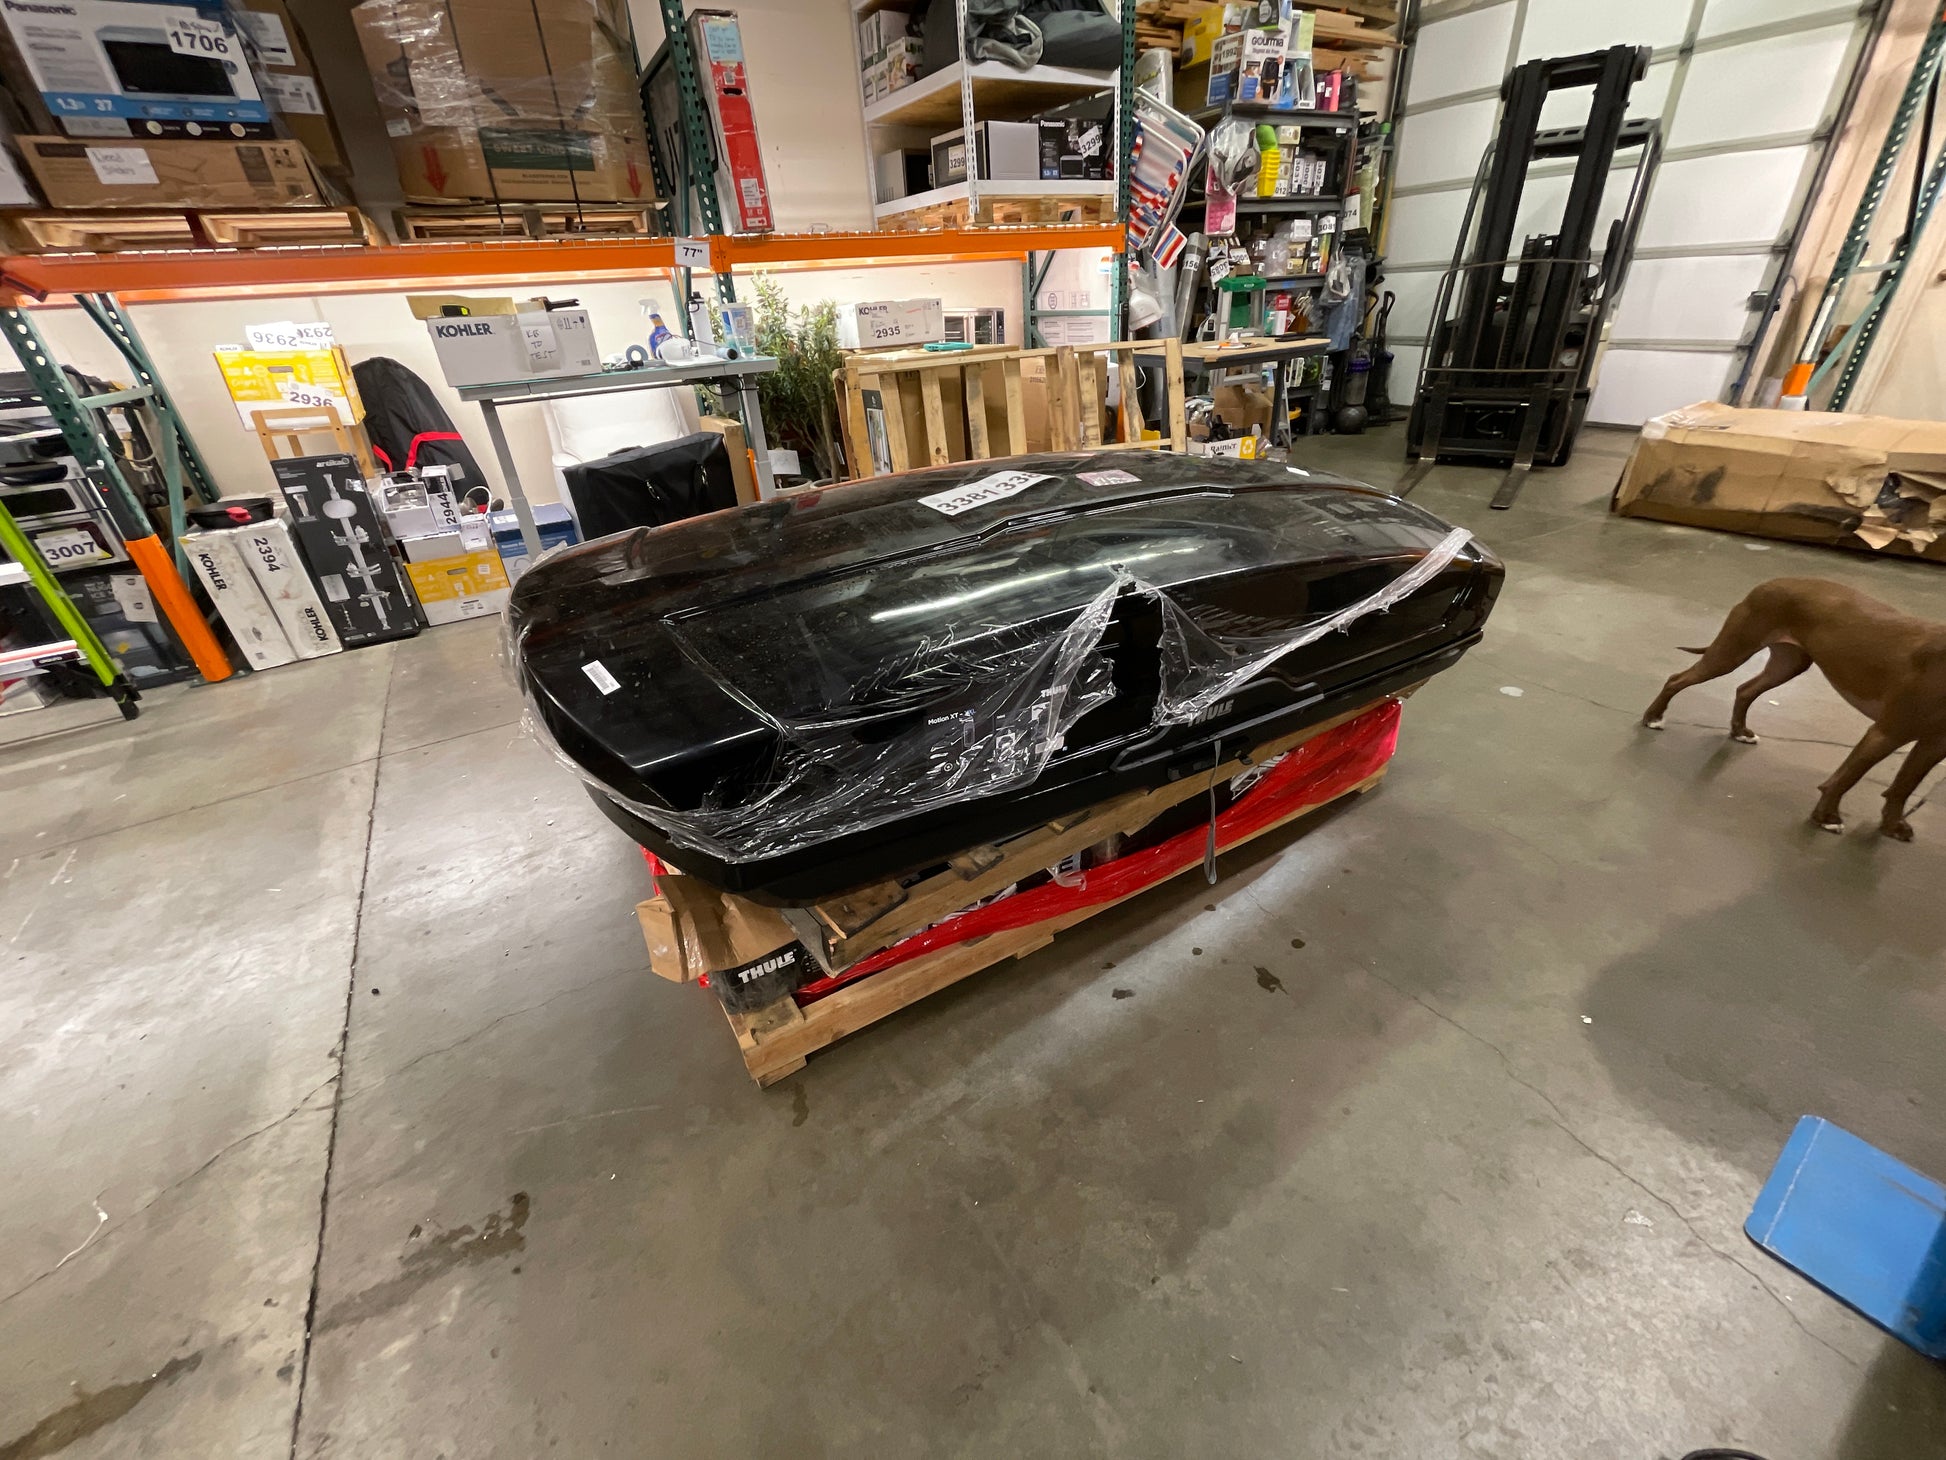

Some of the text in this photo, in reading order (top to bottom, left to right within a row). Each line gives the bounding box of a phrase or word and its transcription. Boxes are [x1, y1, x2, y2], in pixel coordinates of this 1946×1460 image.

[4, 0, 78, 16] Panasonic
[170, 30, 229, 54] 1706
[94, 98, 113, 112] 37
[1040, 120, 1066, 128] Panasonic
[1081, 134, 1101, 154] 3299
[949, 156, 966, 169] 3299
[252, 331, 298, 347] 2936
[435, 322, 493, 338] KOHLER
[875, 325, 901, 339] 2935
[530, 350, 557, 362] TEST
[437, 493, 458, 525] 2944
[936, 488, 998, 513] 3381
[46, 541, 96, 561] 3007
[253, 536, 281, 573] 2394
[198, 552, 227, 591] KOHLER
[304, 606, 329, 642] KOHLER
[927, 716, 949, 726] Motion
[737, 951, 796, 984] THULE
